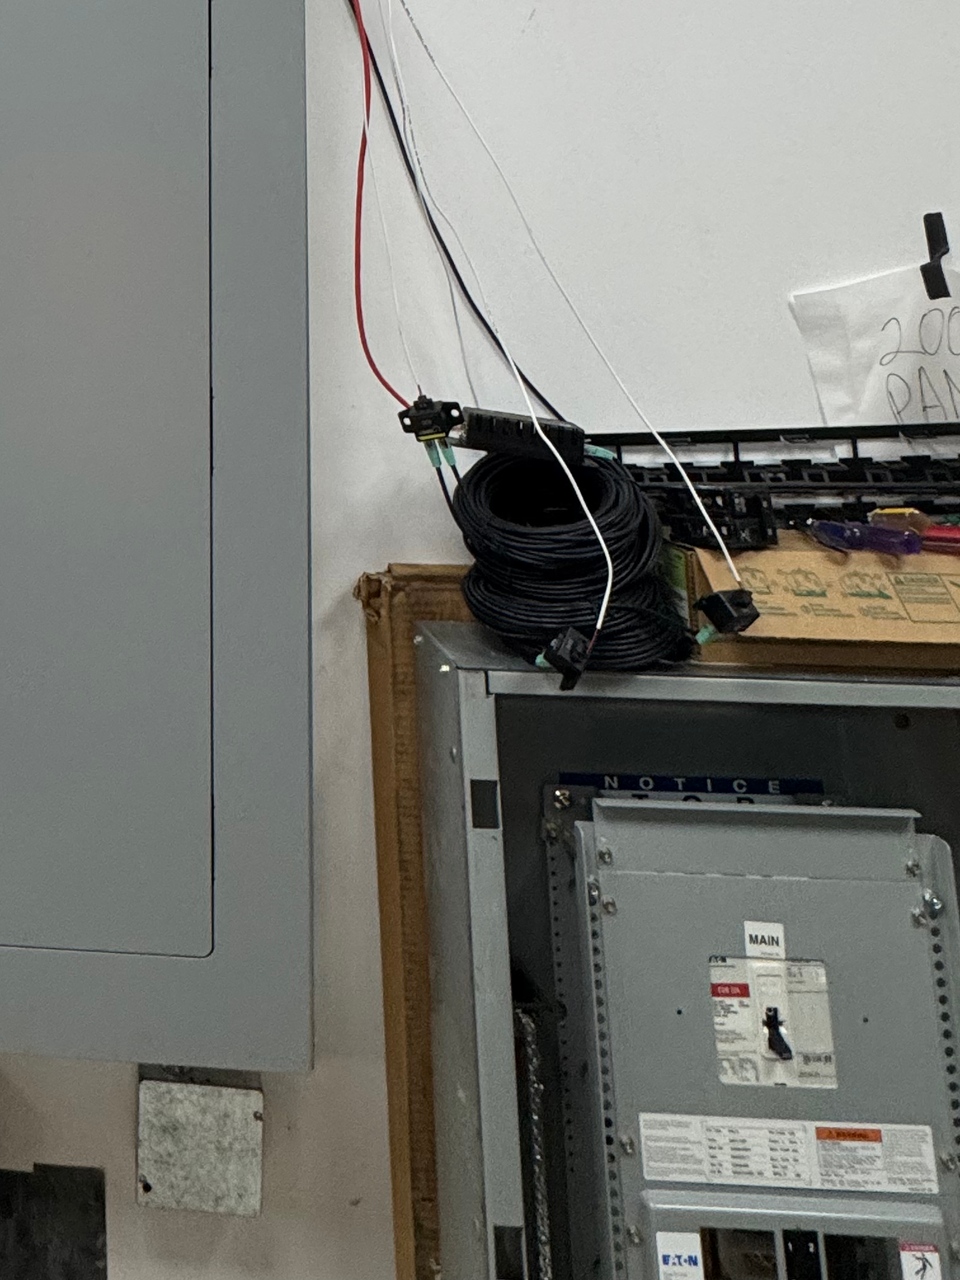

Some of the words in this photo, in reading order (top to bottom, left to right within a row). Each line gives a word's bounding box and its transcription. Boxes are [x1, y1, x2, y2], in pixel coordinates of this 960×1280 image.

[604, 776, 780, 794] NOTICE
[749, 934, 780, 946] MAIN
[788, 1242, 792, 1251] 1
[662, 1254, 698, 1267] EATON
